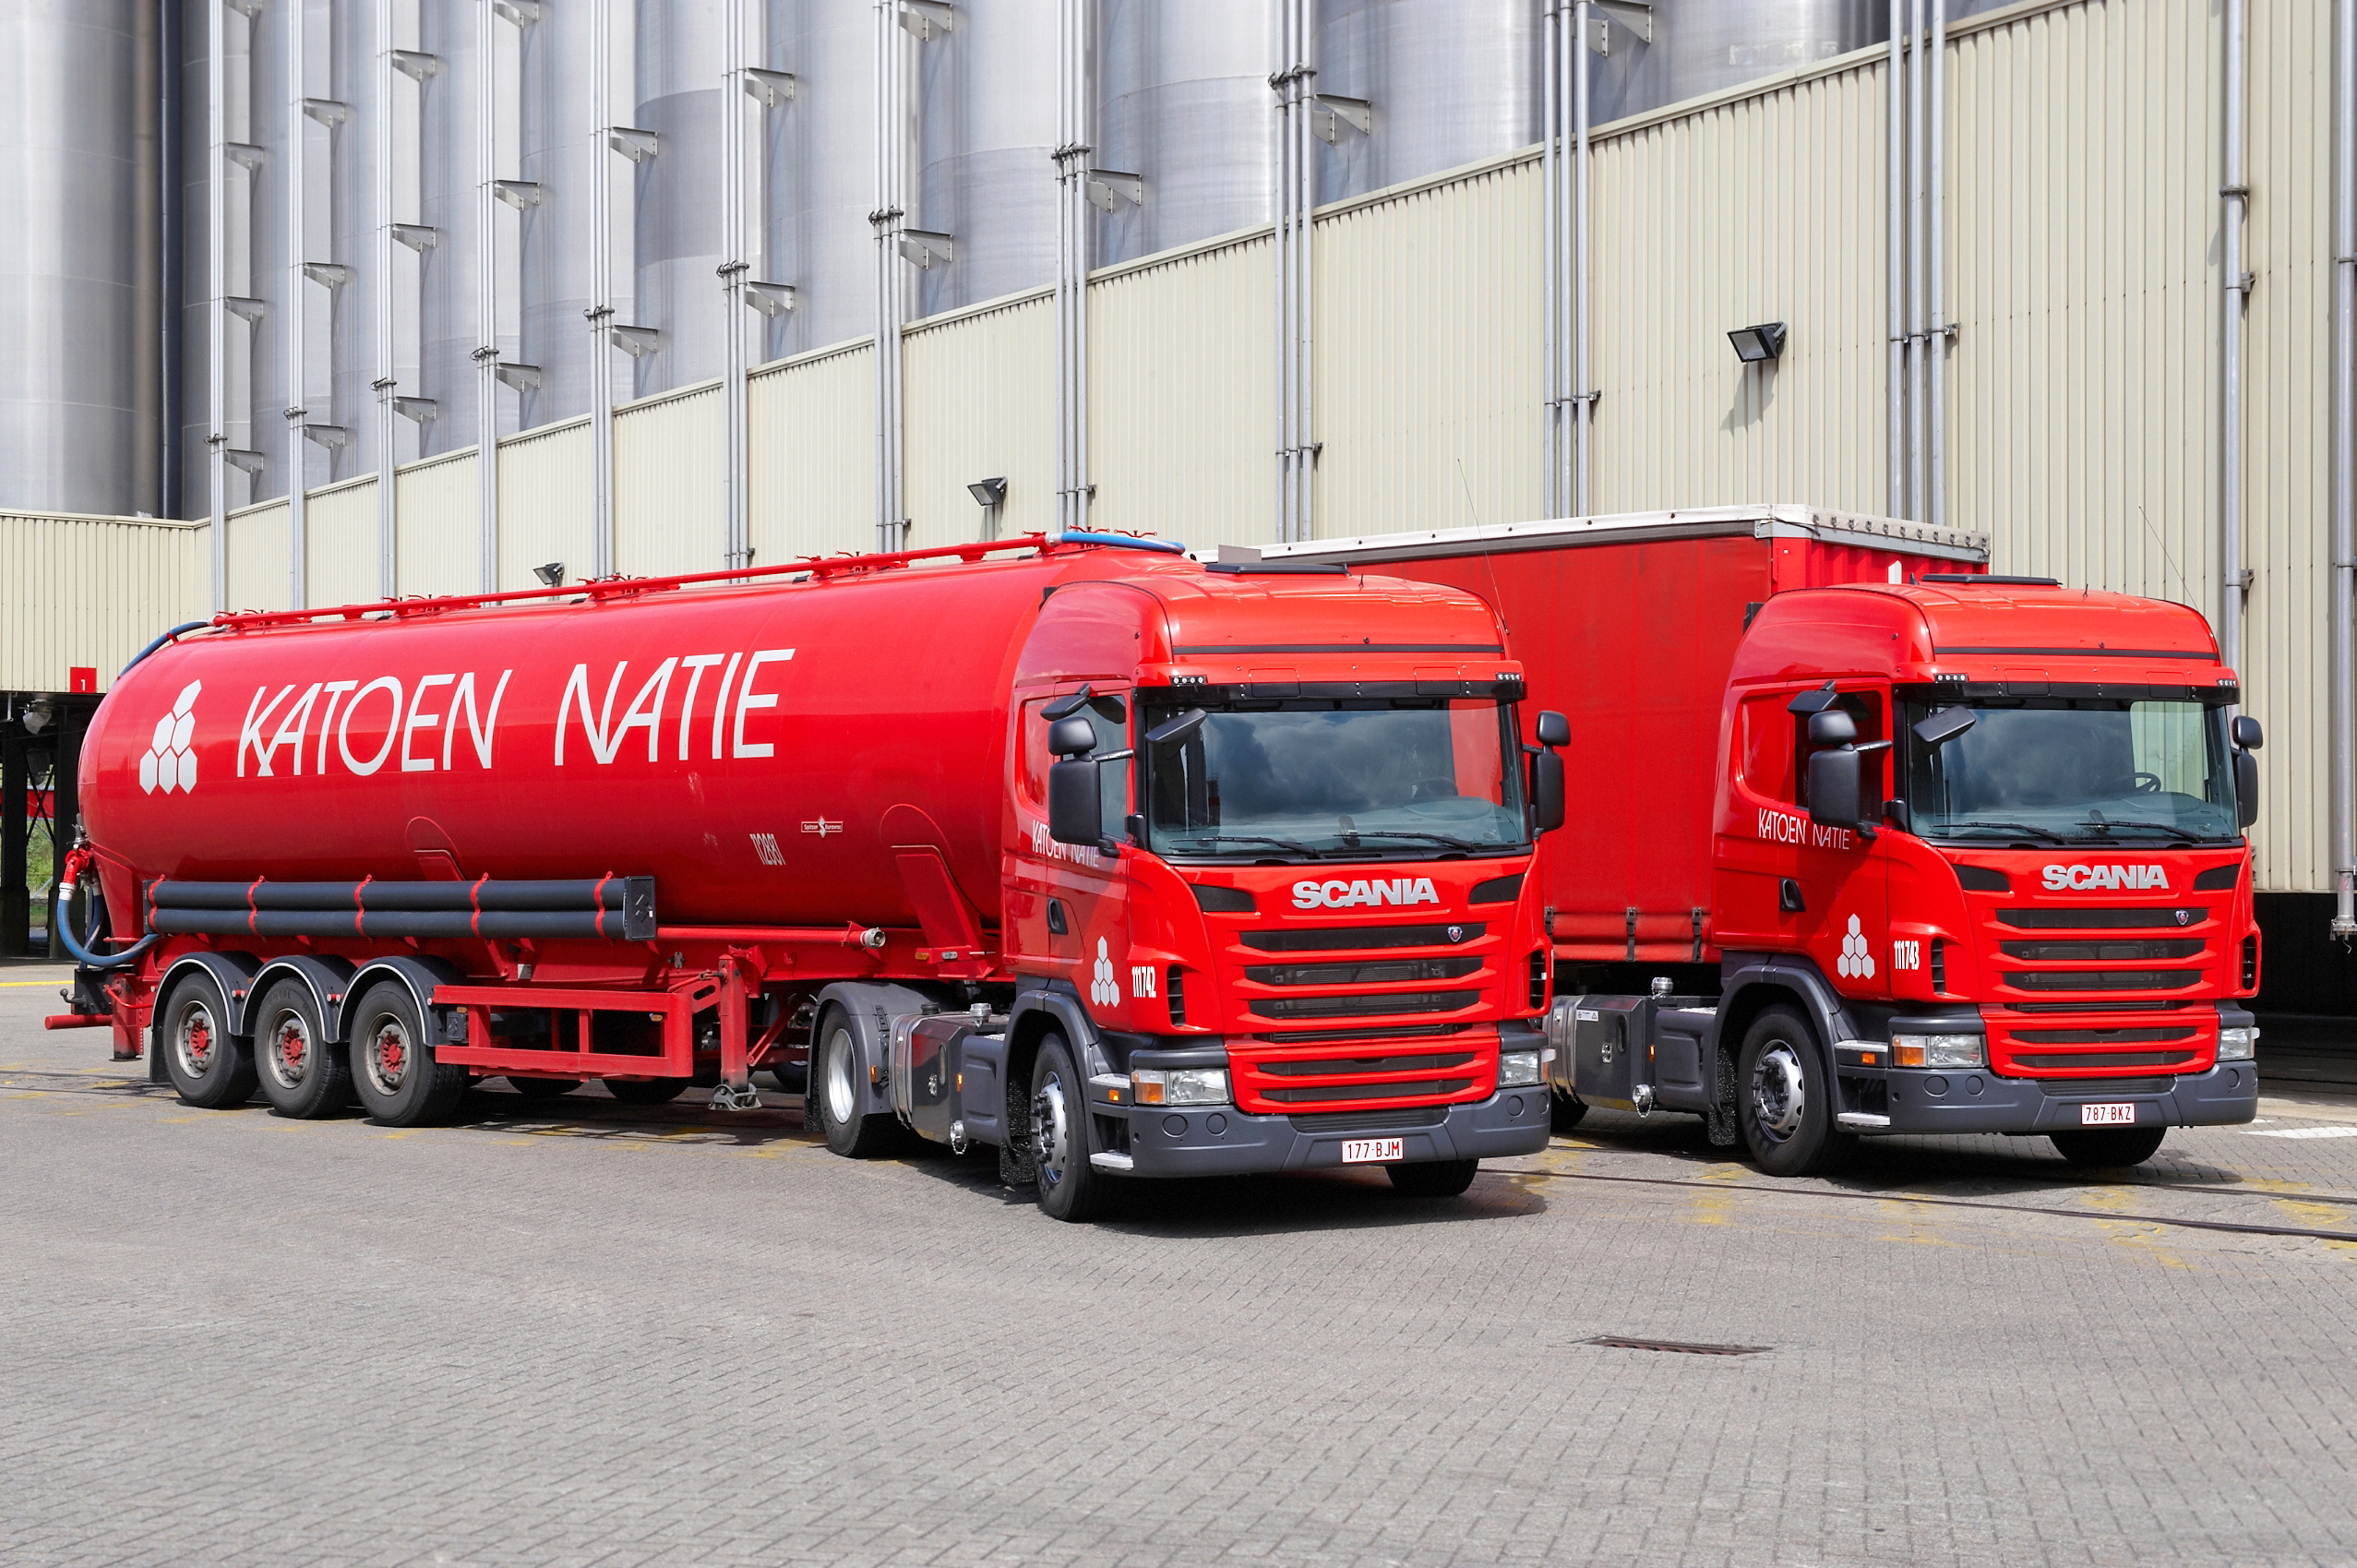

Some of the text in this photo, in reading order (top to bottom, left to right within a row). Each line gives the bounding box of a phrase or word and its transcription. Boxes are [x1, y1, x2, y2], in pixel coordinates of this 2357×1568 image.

[80, 678, 86, 691] 1
[237, 649, 796, 777] KATOEN NATIE
[1032, 819, 1067, 861] KATOEN
[1758, 808, 1850, 850] KATOEN NATIE
[749, 832, 786, 866] 112881
[1292, 878, 1440, 909] SCANIA
[2041, 864, 2170, 891] SCANIA
[1894, 940, 1920, 971] 111743
[1131, 965, 1156, 999] 111742
[1347, 1141, 1400, 1159] 177-BJM
